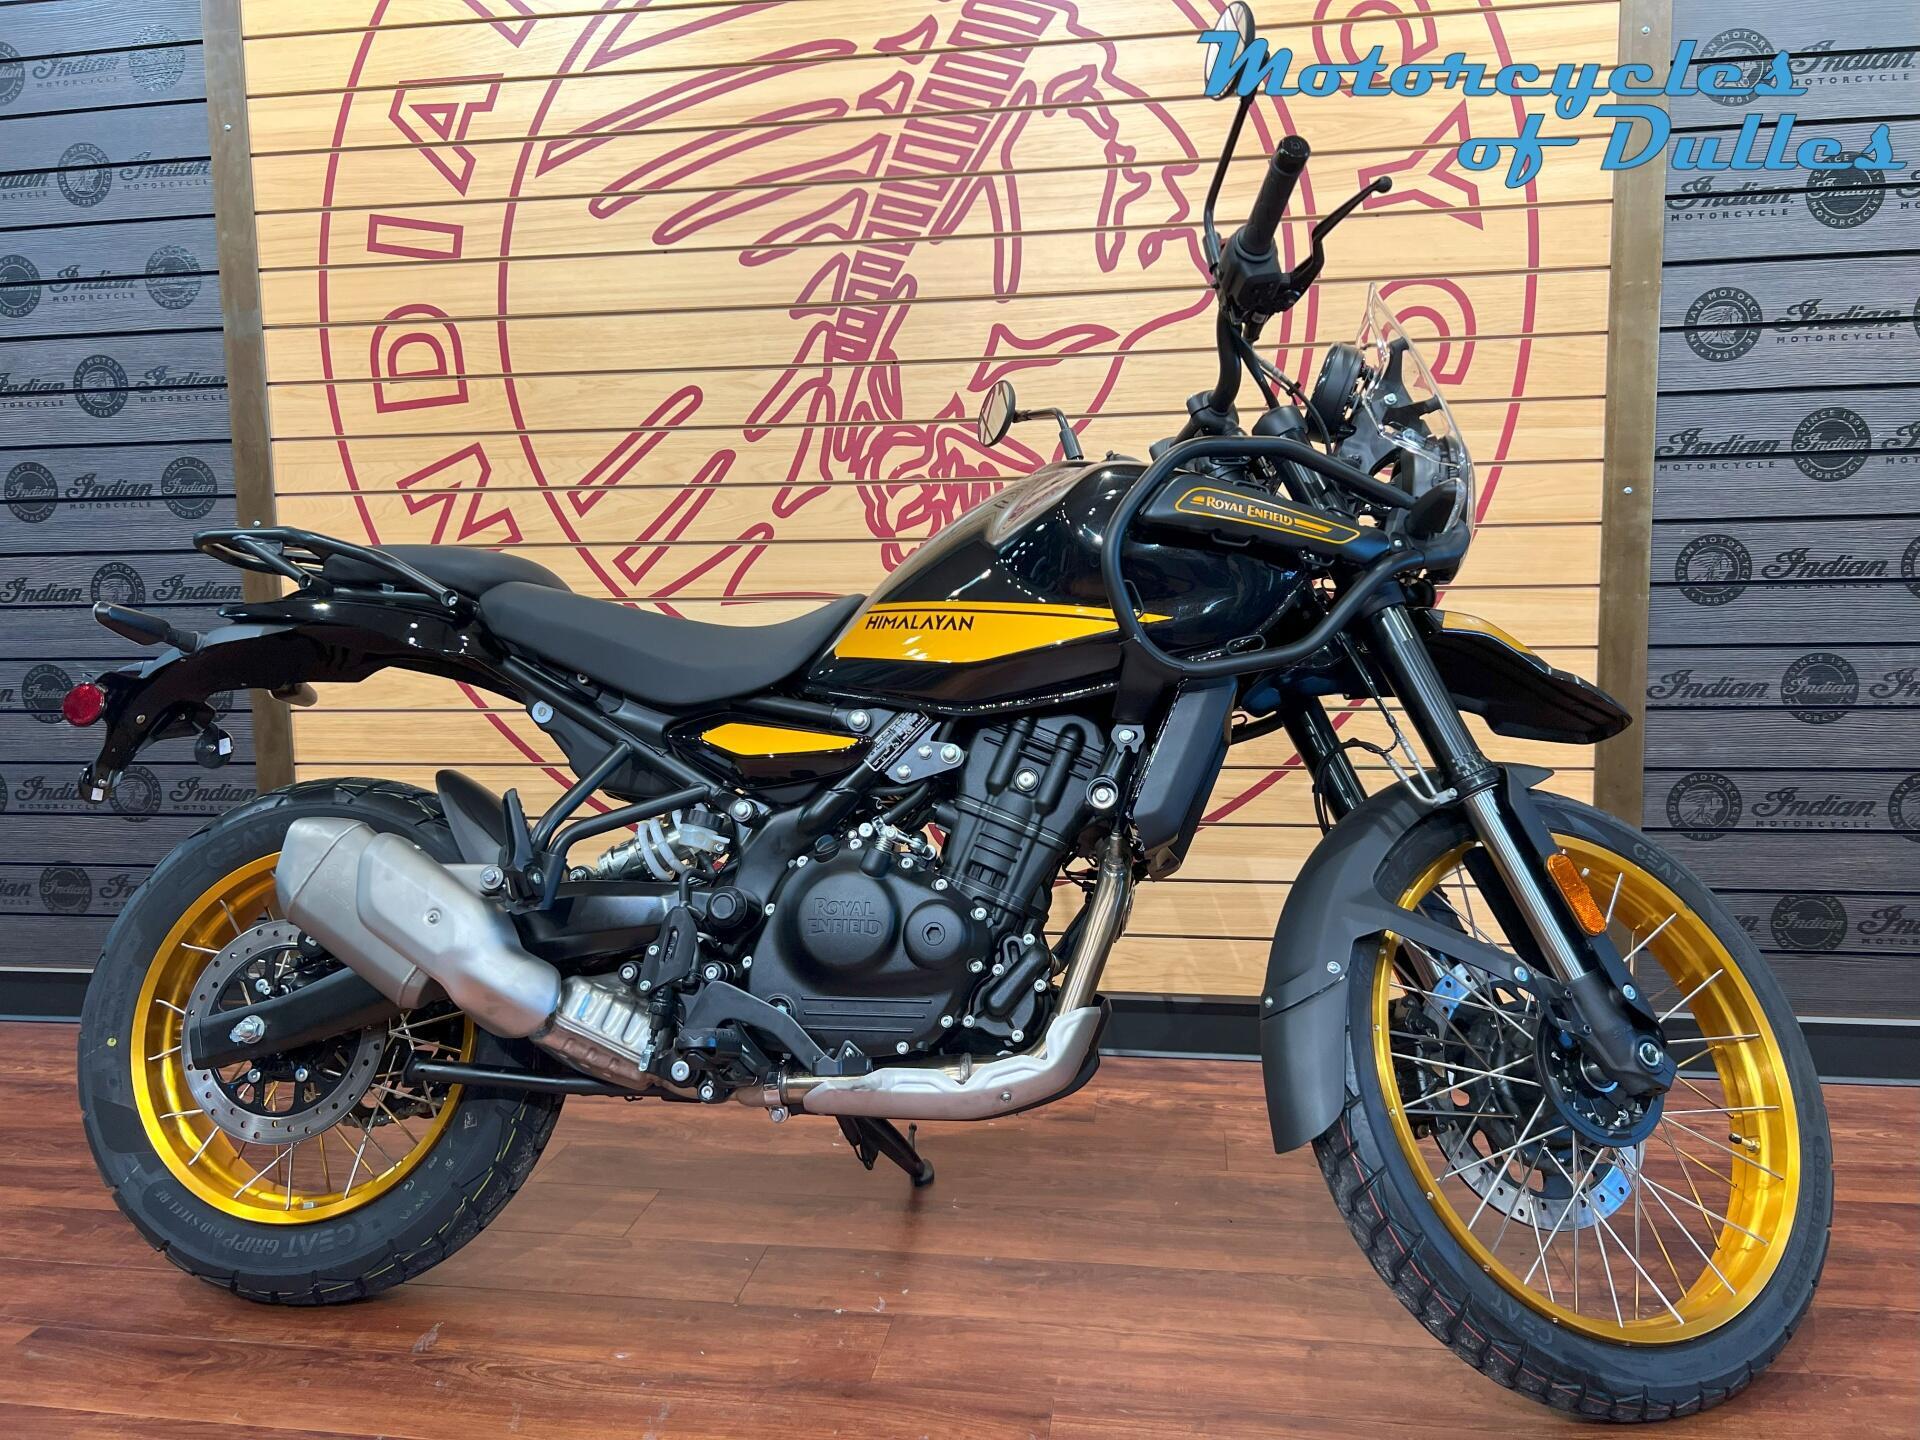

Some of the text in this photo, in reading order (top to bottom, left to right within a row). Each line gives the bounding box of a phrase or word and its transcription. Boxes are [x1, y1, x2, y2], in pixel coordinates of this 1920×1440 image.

[1787, 40, 1916, 75] Indian
[1792, 73, 1910, 86] MOTORCYCLE
[123, 180, 209, 190] MOTORCYCLE
[1666, 175, 1794, 211] Indian
[1671, 208, 1789, 221] MOTORCYCLE
[366, 0, 540, 546] NDIA
[53, 292, 136, 302] MOTORCYCLE
[1776, 332, 1896, 344] MOTORCYCLE
[135, 366, 226, 393] Indian
[0, 400, 65, 410] TORCYCLE
[139, 394, 225, 403] MOTORCYCLE
[1654, 427, 1782, 456] Indian
[1793, 432, 1870, 452] Indian
[1659, 460, 1776, 472] MOTORCYCLE
[6, 482, 56, 498] Indian
[65, 473, 153, 499] Indian
[162, 477, 215, 495] Indian
[69, 501, 151, 510] MOTORCYCLE
[1205, 495, 1294, 527] ROYAL ENFIELD
[1760, 547, 1890, 580] Indian
[0, 577, 83, 603] Indian
[152, 573, 242, 602] Indian
[865, 614, 975, 632] HIMALAYAN
[23, 683, 65, 700] India
[1646, 669, 1770, 700] Indian
[1783, 676, 1856, 695] Indian
[168, 776, 257, 803] Indian
[1750, 786, 1877, 818] Indian
[1754, 820, 1872, 829] MOTORCYCLE
[1632, 840, 1687, 887] CEAT
[39, 880, 90, 897] Indian
[811, 896, 876, 917] ROYAL
[807, 917, 883, 937] ENFIELD
[1772, 911, 1844, 930] Indian
[222, 1232, 281, 1256] GRIPP
[282, 1223, 357, 1258] CEAT
